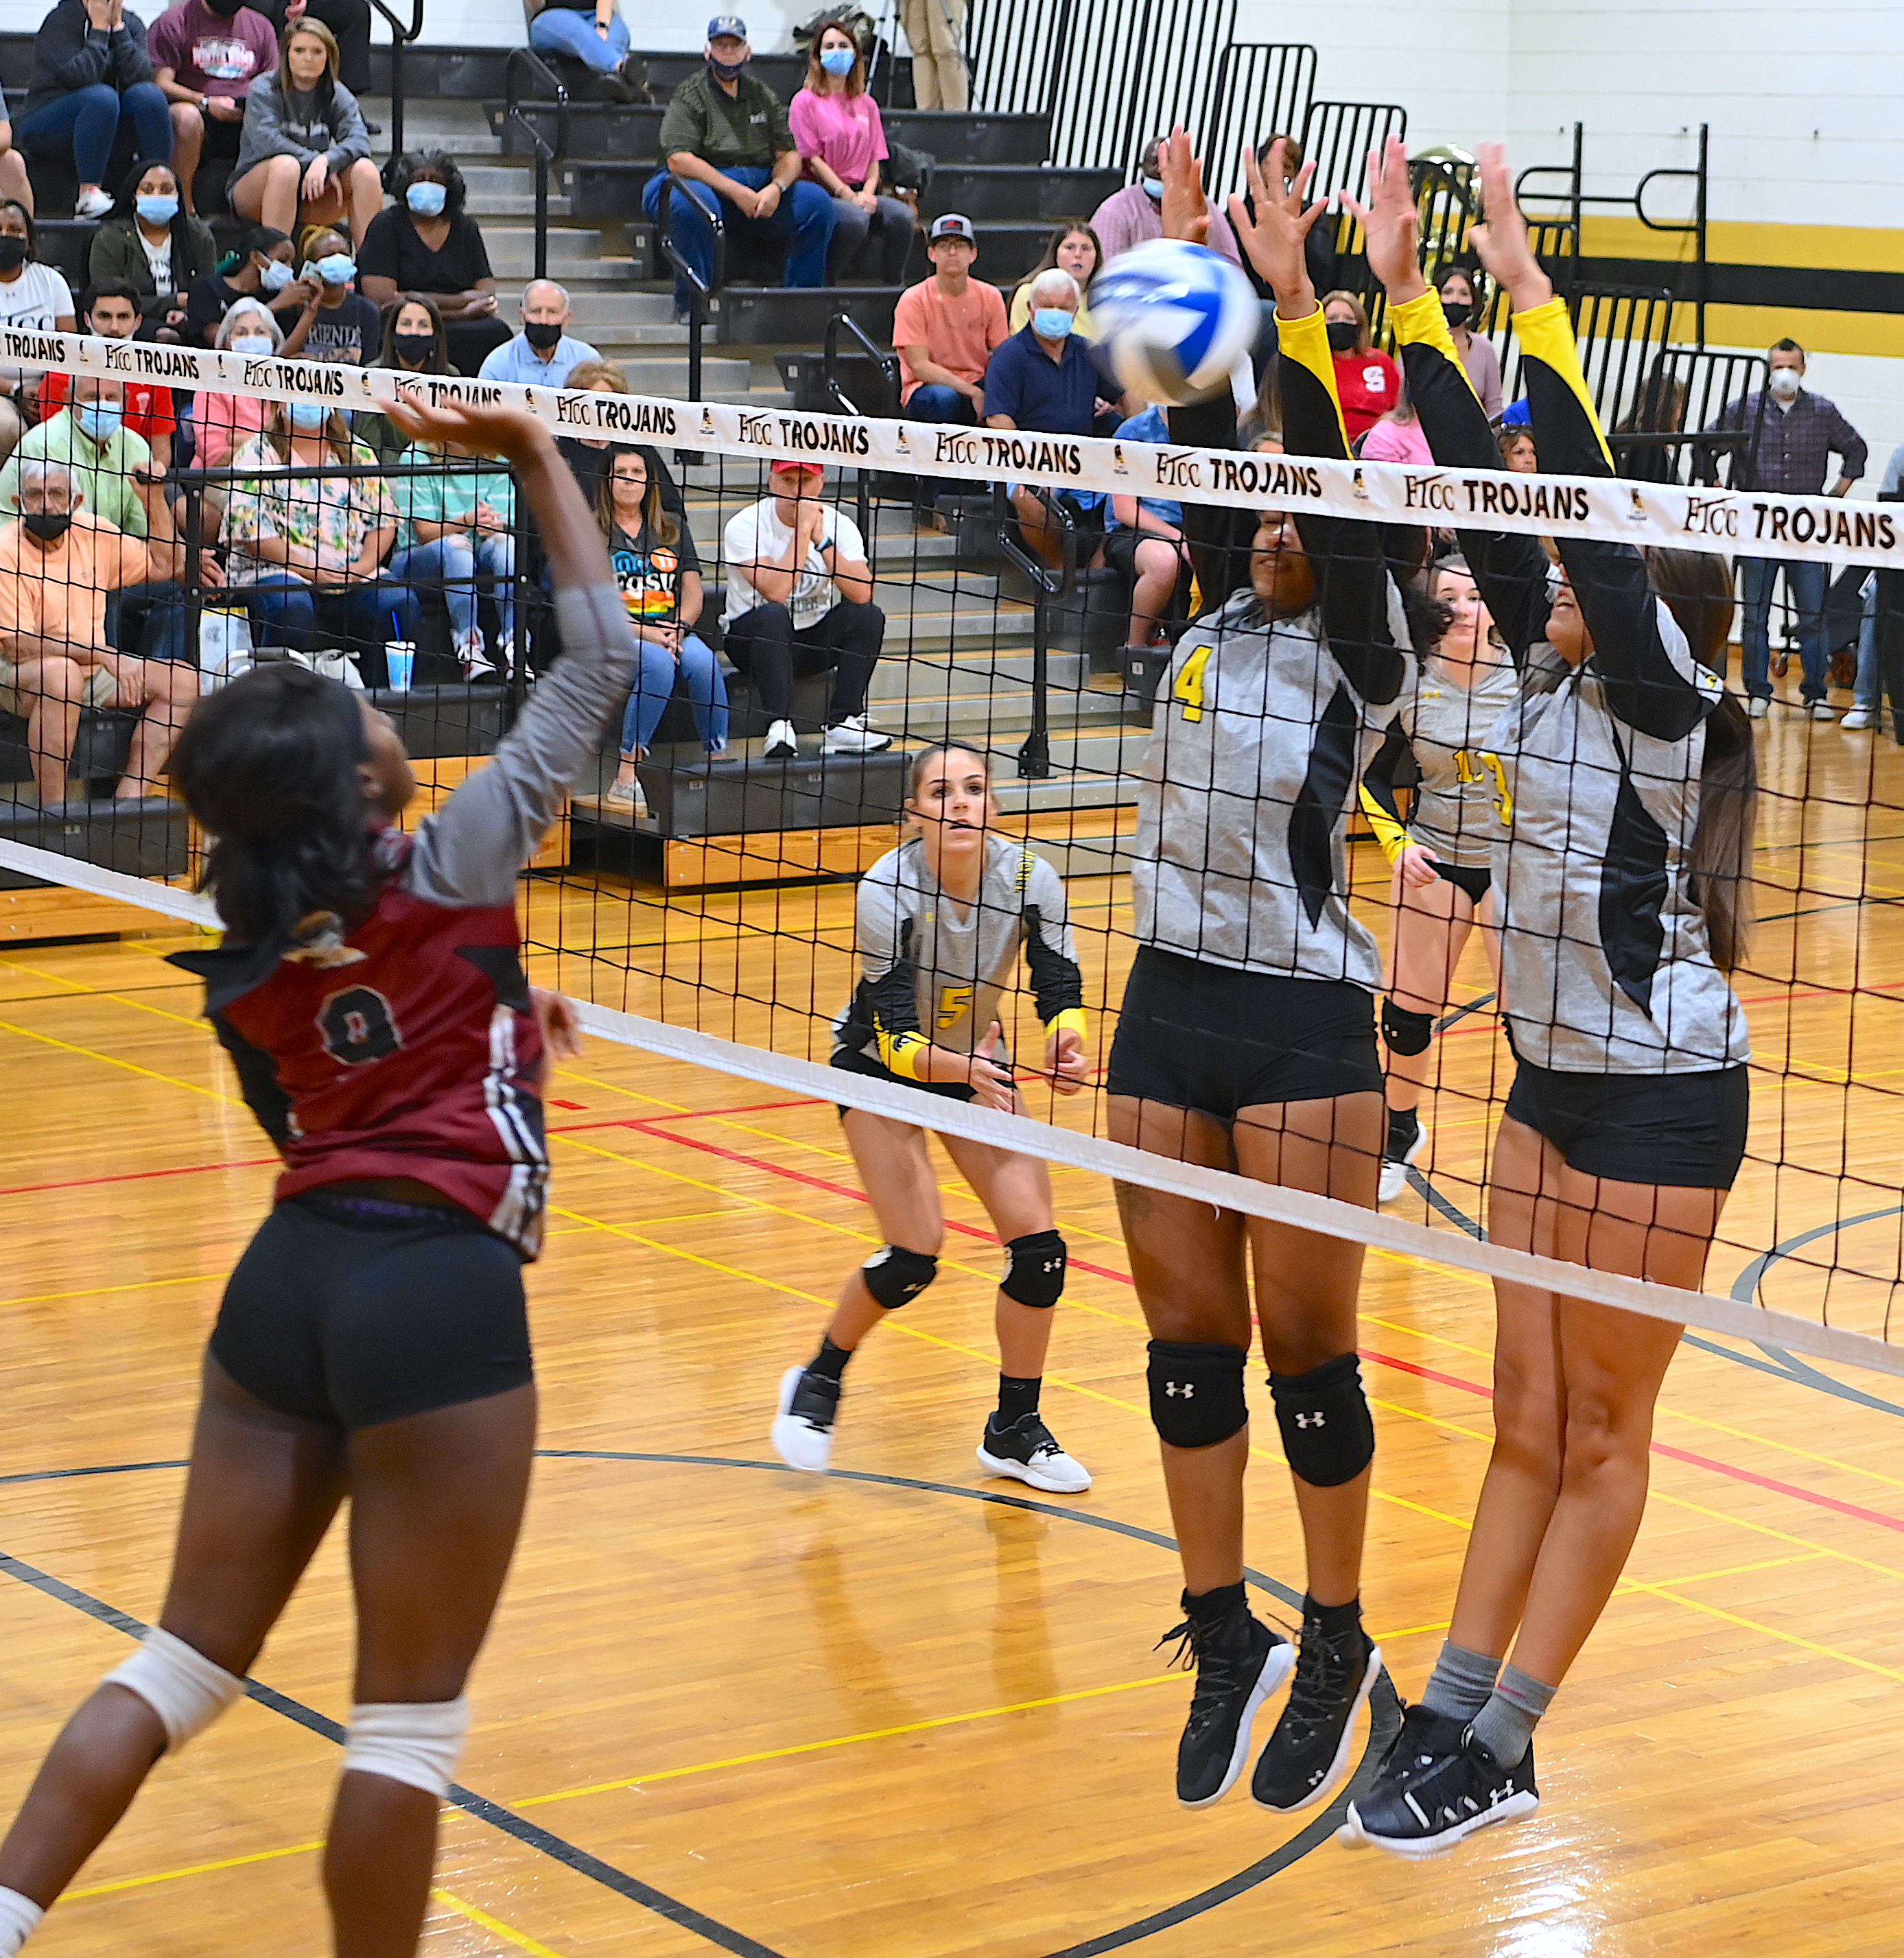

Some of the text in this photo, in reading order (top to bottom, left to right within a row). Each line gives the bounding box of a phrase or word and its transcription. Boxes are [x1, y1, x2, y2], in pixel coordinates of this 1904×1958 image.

[5, 333, 65, 363] TROJANS
[308, 323, 362, 347] RIENDS
[104, 343, 200, 379] FTCC TROJANS
[244, 359, 344, 396] FTCC TROJANS
[556, 393, 677, 436] FTCC TROJANS
[738, 412, 869, 456] FTCC TROJANS
[935, 430, 1081, 475] FTCC TROJANS
[1155, 451, 1322, 497] FTCC TROJANS
[1402, 472, 1589, 521] FTCC TROJANS
[1684, 495, 1896, 550] FTCC TROJANS
[1174, 644, 1213, 724] 4
[937, 985, 972, 1030] 5
